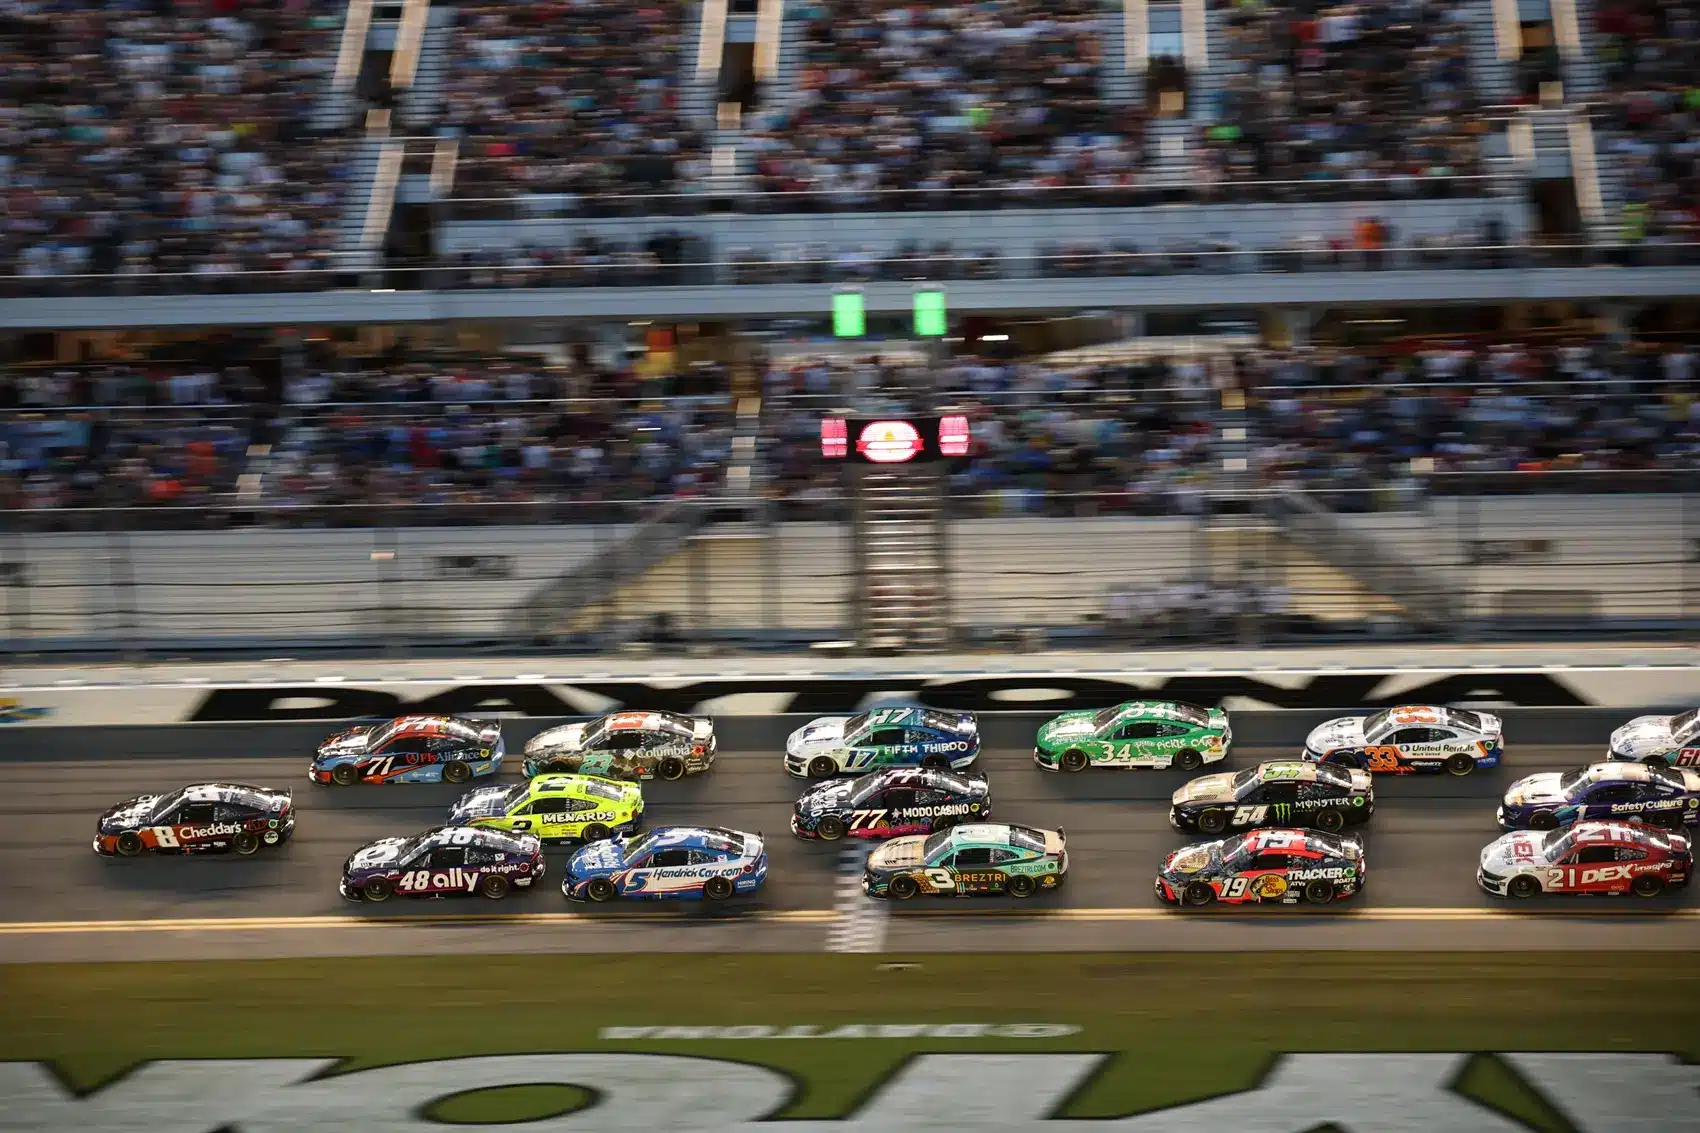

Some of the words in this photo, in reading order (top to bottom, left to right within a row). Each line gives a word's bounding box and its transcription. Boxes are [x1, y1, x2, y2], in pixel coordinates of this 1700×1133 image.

[189, 674, 1592, 721] DAYTONA
[636, 745, 690, 758] Columbia
[845, 748, 878, 768] 17
[884, 744, 918, 755] FIFTH
[1099, 743, 1132, 762] 34
[1365, 747, 1398, 768] 33
[1412, 744, 1441, 752] United
[1443, 744, 1475, 753] Rentals
[366, 756, 396, 776] 71
[578, 755, 613, 773] 23
[902, 807, 933, 818] MODO
[933, 803, 970, 817] CASINO
[1295, 798, 1350, 809] MONSTER
[542, 811, 616, 824] MENARDS
[850, 809, 888, 831] 77
[1231, 804, 1269, 826] 54
[153, 826, 180, 848] 8
[180, 822, 241, 839] Cheddar's
[925, 868, 956, 889] 3
[955, 873, 1006, 882] BREZTRI
[1011, 863, 1046, 874] BREZTRI.COM
[1287, 867, 1343, 880] TRACKER
[1547, 868, 1575, 888] 21
[1581, 864, 1632, 884] DEX
[399, 870, 430, 891] 48
[432, 867, 479, 892] ally
[624, 871, 650, 892] 5
[1220, 877, 1249, 897] 19
